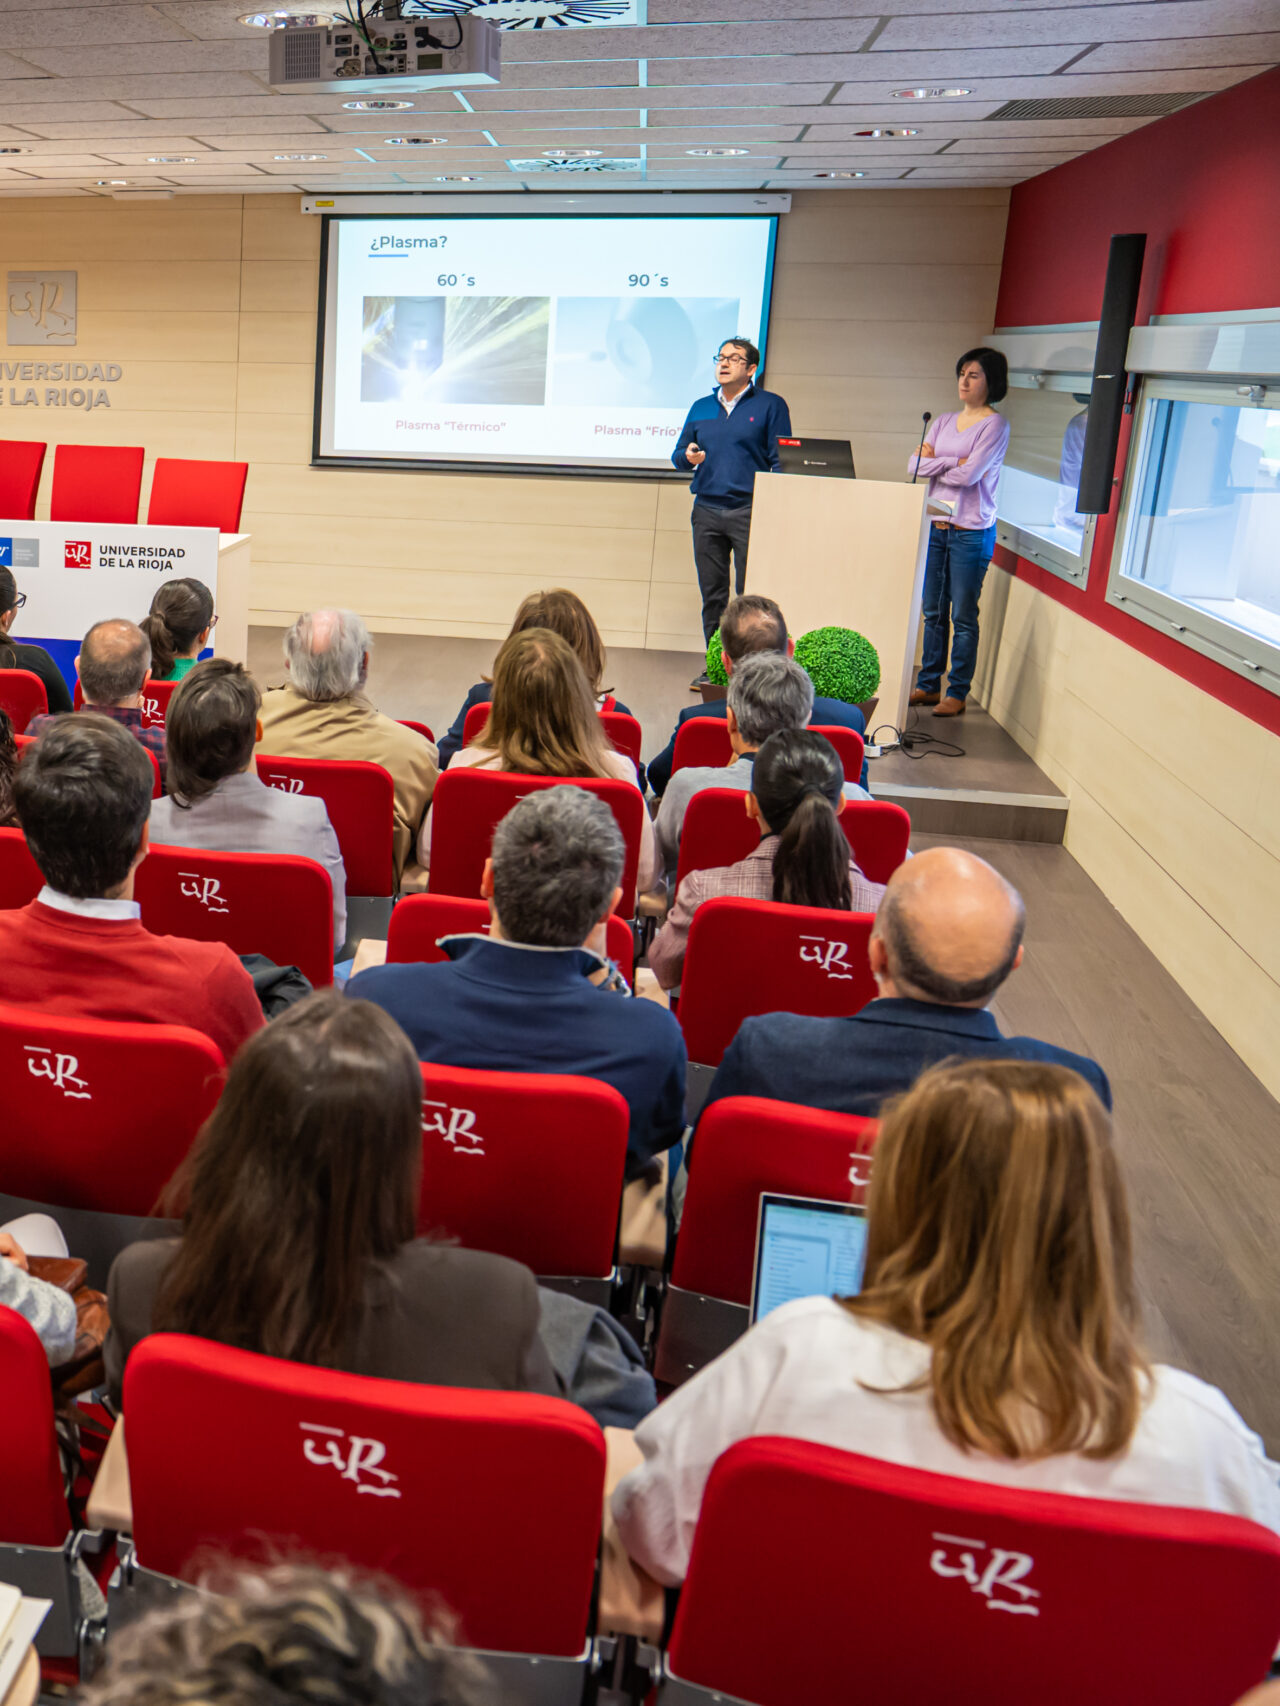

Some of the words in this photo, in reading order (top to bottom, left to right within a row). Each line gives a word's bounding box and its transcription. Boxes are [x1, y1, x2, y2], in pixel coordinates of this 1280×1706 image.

[370, 235, 448, 251] ¿Plasma?
[9, 388, 39, 406] LA
[45, 388, 111, 412] RIOJA
[395, 420, 441, 431] Plasma
[594, 424, 642, 437] Plasma
[99, 545, 186, 558] UNIVERSIDAD
[99, 557, 115, 568] DE
[119, 558, 135, 569] LA
[138, 559, 173, 571] RIOJA
